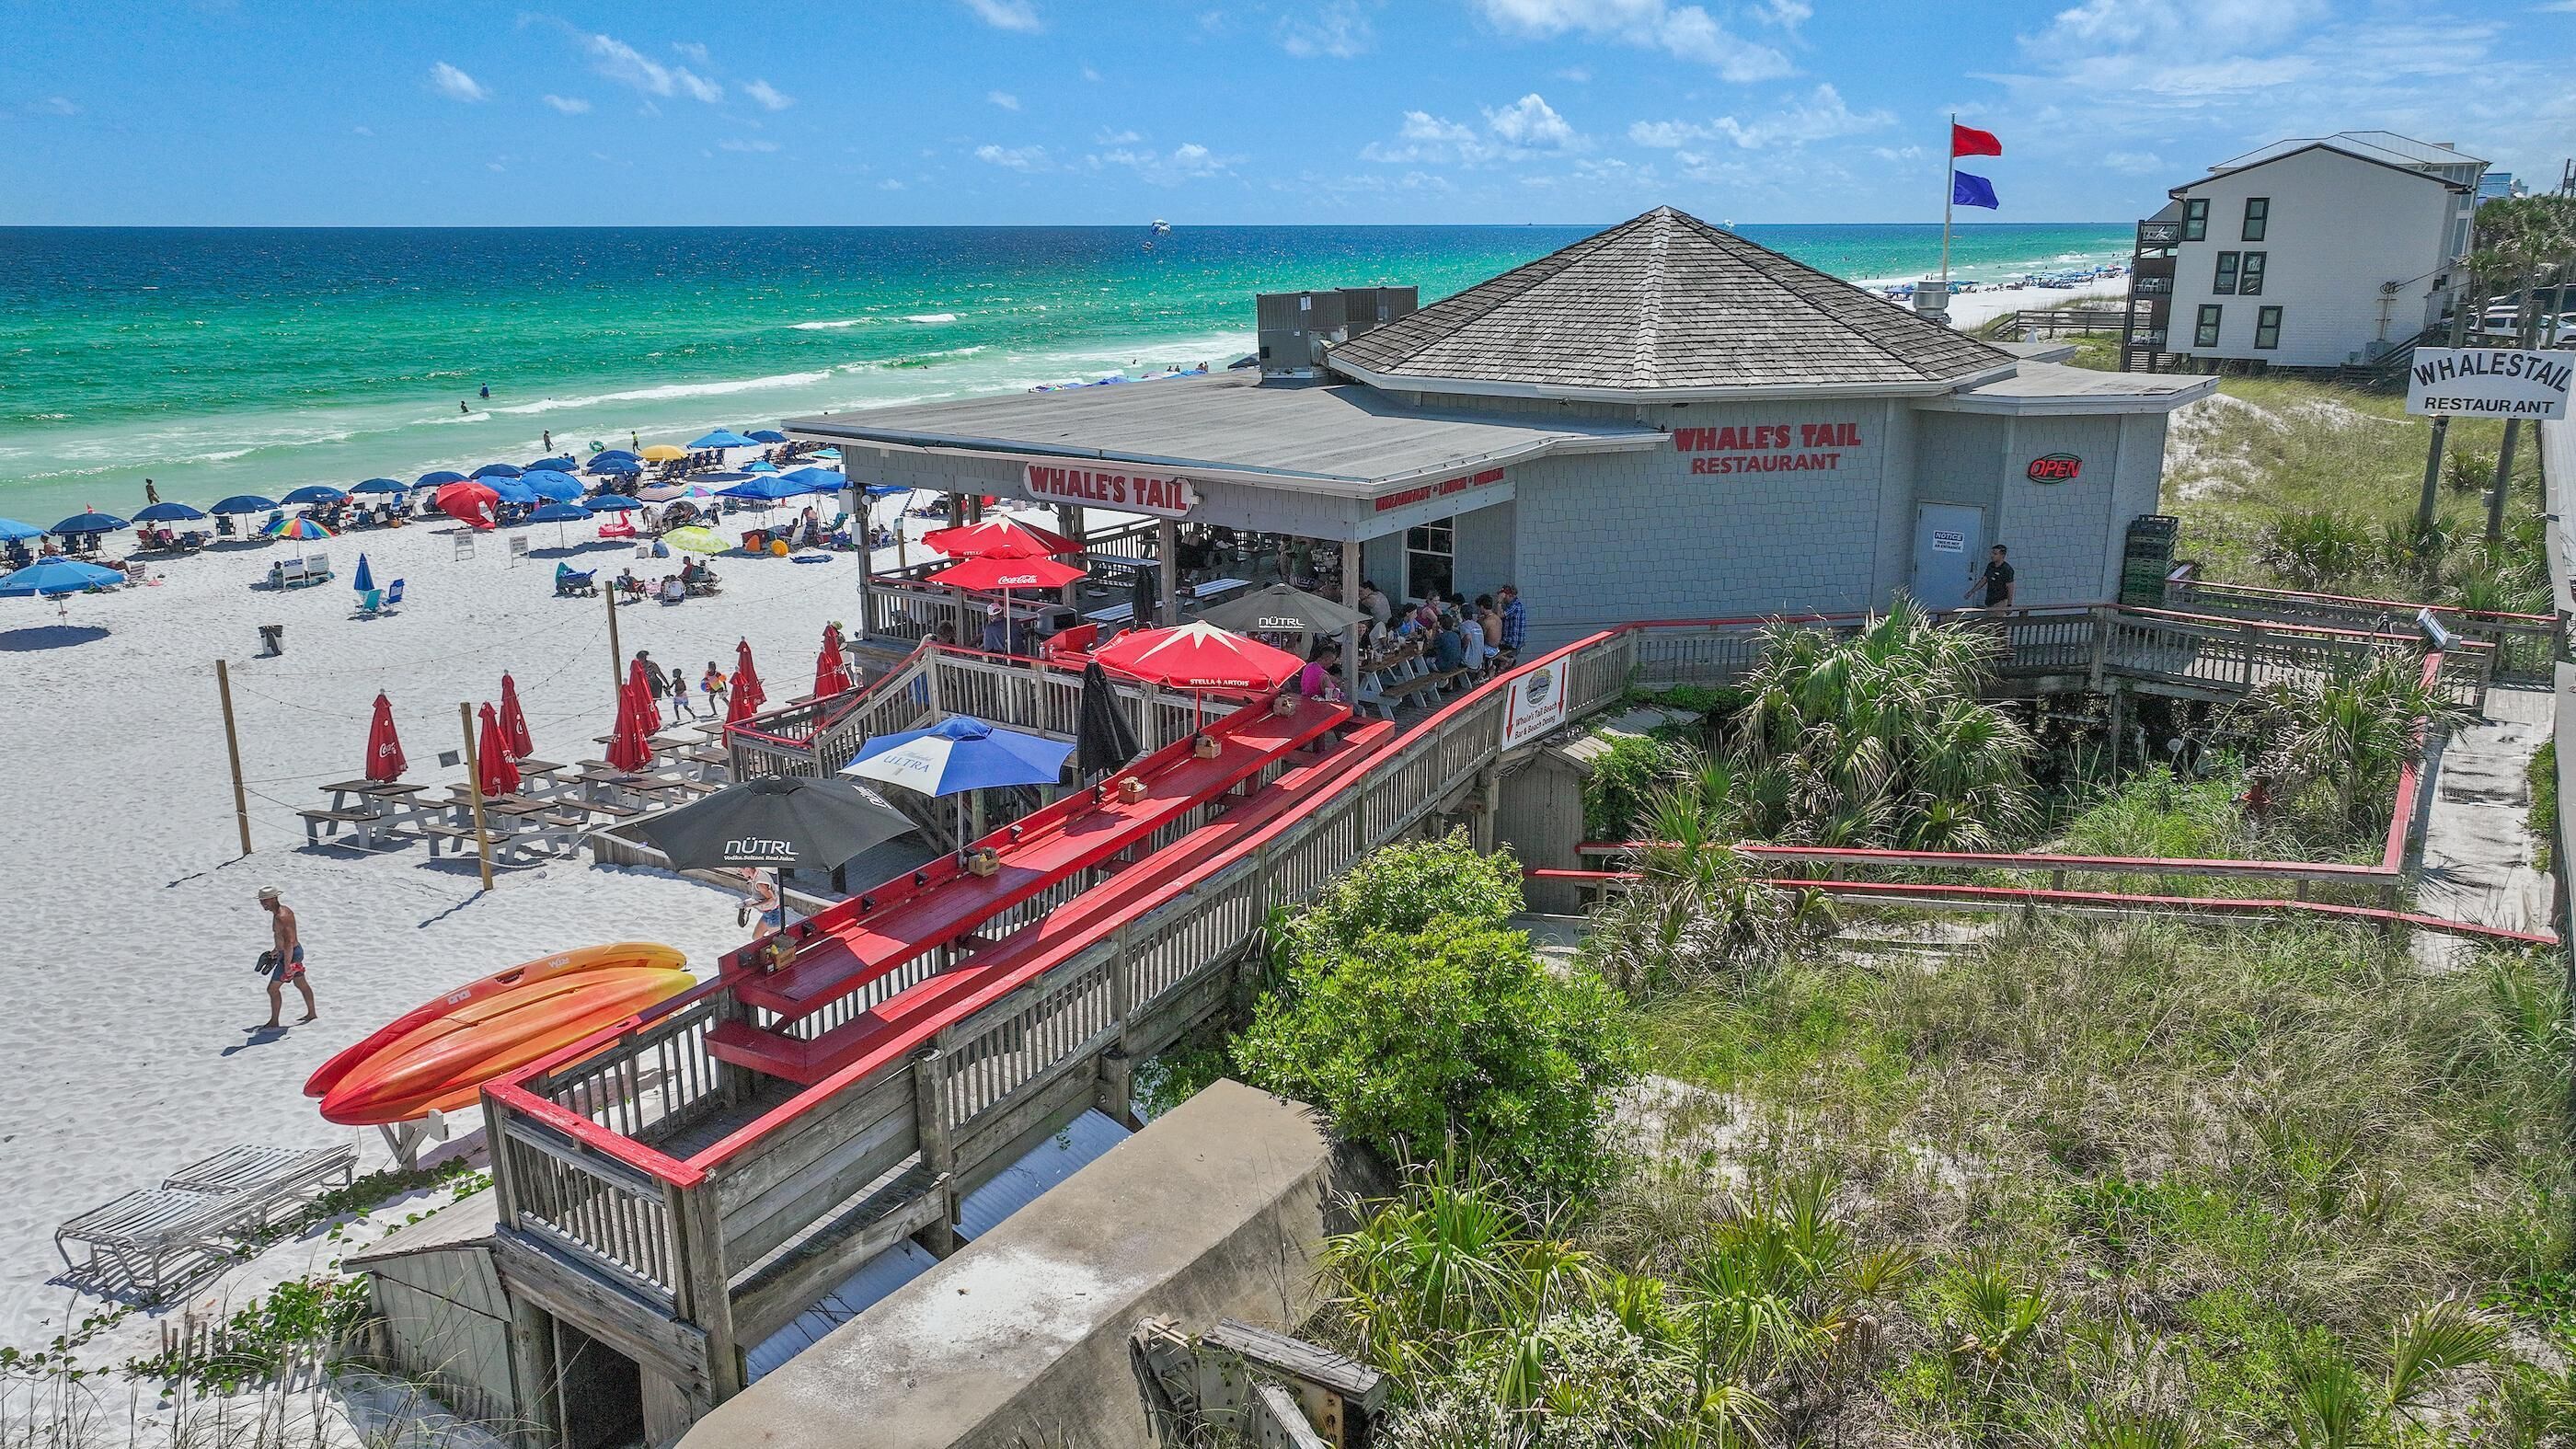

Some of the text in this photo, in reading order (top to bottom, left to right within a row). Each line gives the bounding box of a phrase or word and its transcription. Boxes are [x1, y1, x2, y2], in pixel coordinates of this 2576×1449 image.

[2413, 352, 2572, 393] WHALESTAIL
[2424, 397, 2555, 414] RESTAURANT
[1673, 423, 1861, 452] WHALE'S TAIL
[1692, 454, 1840, 475] RESTAURANT
[2030, 459, 2082, 477] OPEN
[1029, 466, 1188, 512] WHALE'S TAIL
[997, 574, 1038, 585] Coca-Cola
[1223, 679, 1250, 687] ARTOIS
[1516, 712, 1535, 726] Whale's
[1535, 707, 1543, 719] Tail
[1544, 700, 1557, 714] Beach
[1515, 730, 1524, 739] Bar
[1528, 720, 1542, 733] Beach
[1542, 715, 1556, 726] Dining
[883, 754, 930, 773] ULTRA
